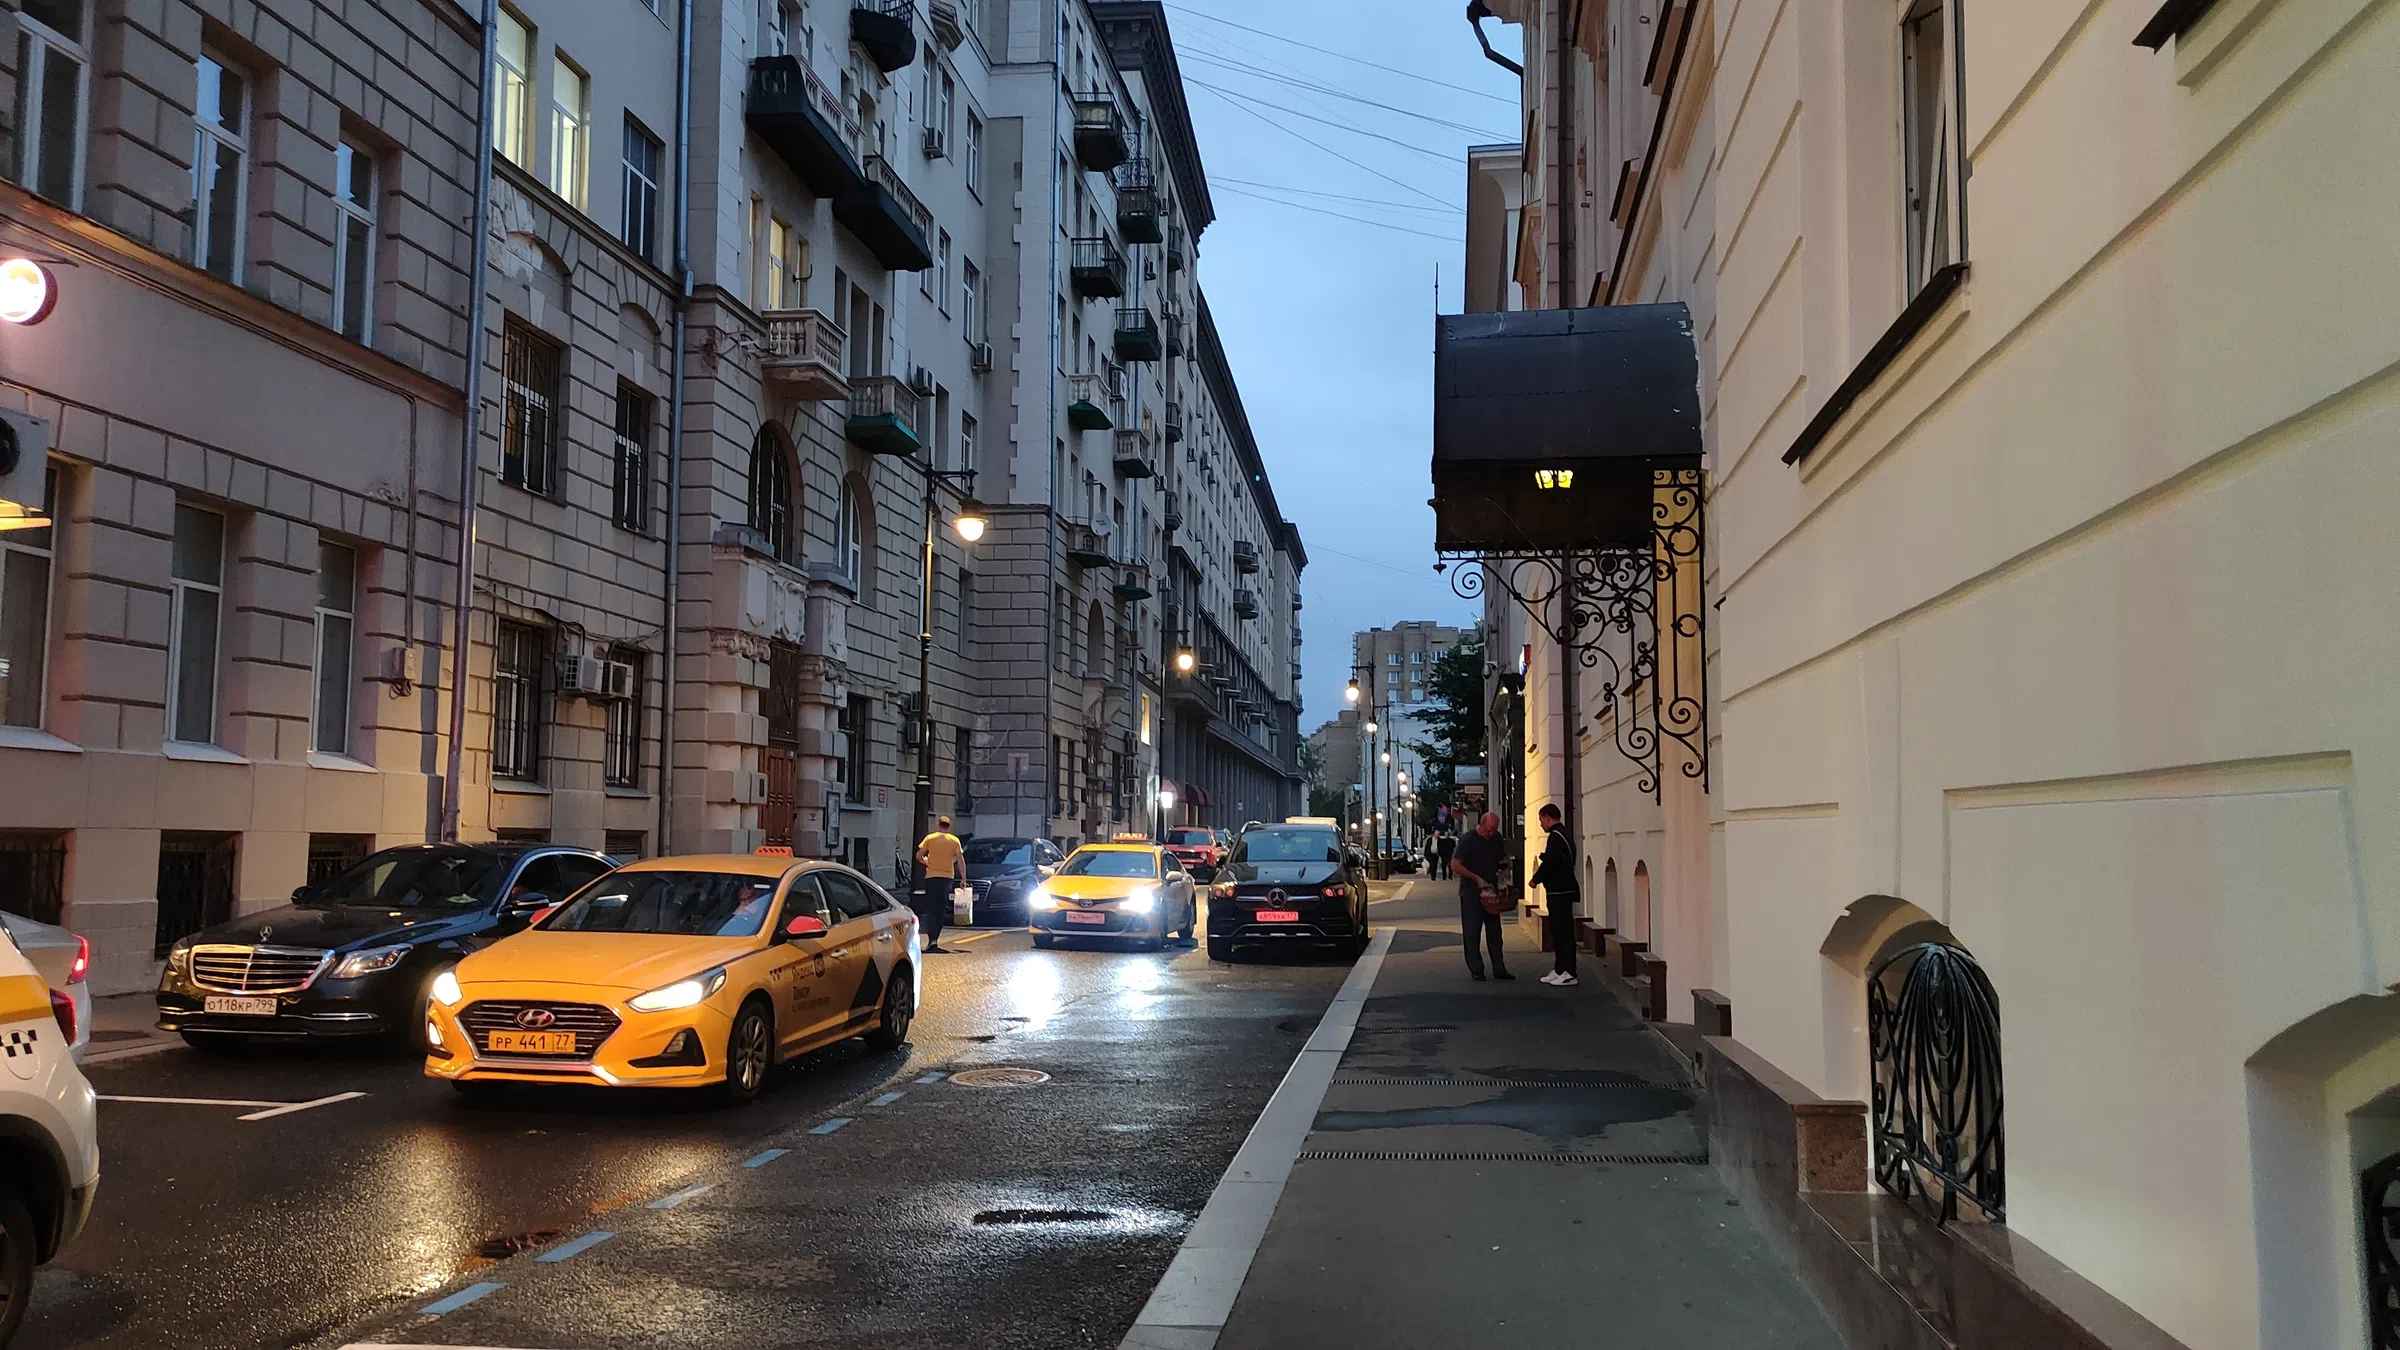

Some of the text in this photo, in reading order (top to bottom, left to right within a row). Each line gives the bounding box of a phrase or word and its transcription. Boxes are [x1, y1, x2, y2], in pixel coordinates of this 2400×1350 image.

[255, 999, 273, 1009] 799
[519, 1035, 546, 1049] 441
[556, 1034, 570, 1046] 77
